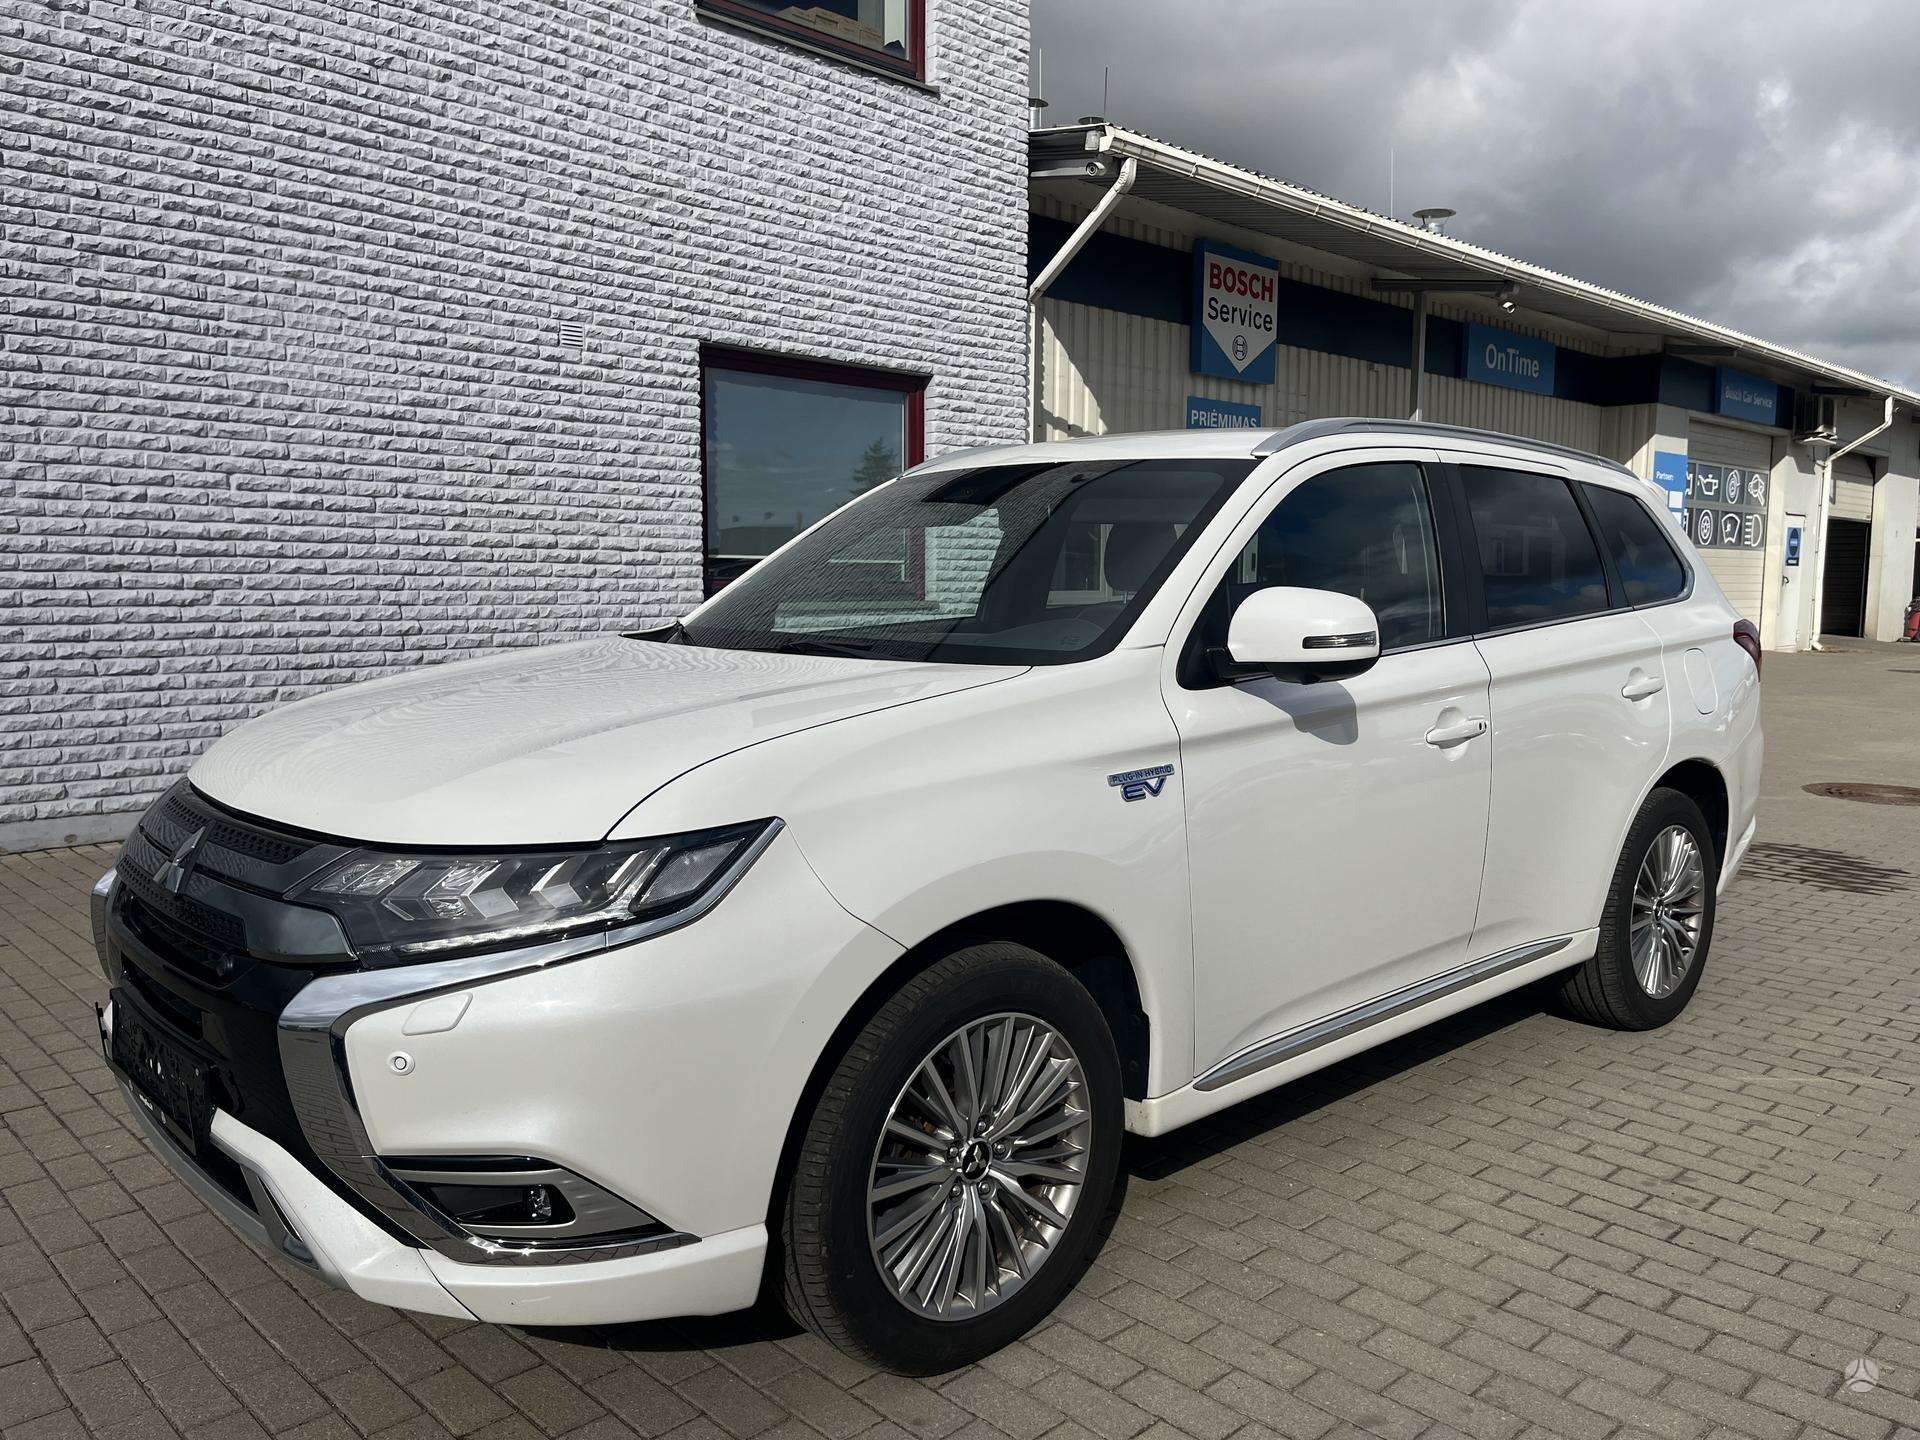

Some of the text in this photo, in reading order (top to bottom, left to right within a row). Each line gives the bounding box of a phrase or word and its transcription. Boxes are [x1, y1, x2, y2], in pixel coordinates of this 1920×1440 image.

[1209, 262, 1274, 302] BOSCH
[1207, 297, 1273, 332] Service
[1485, 343, 1540, 378] OnTime
[1191, 409, 1257, 428] PRIĖMIMAS
[1145, 764, 1172, 778] HYBRID
[1120, 776, 1167, 802] EV
